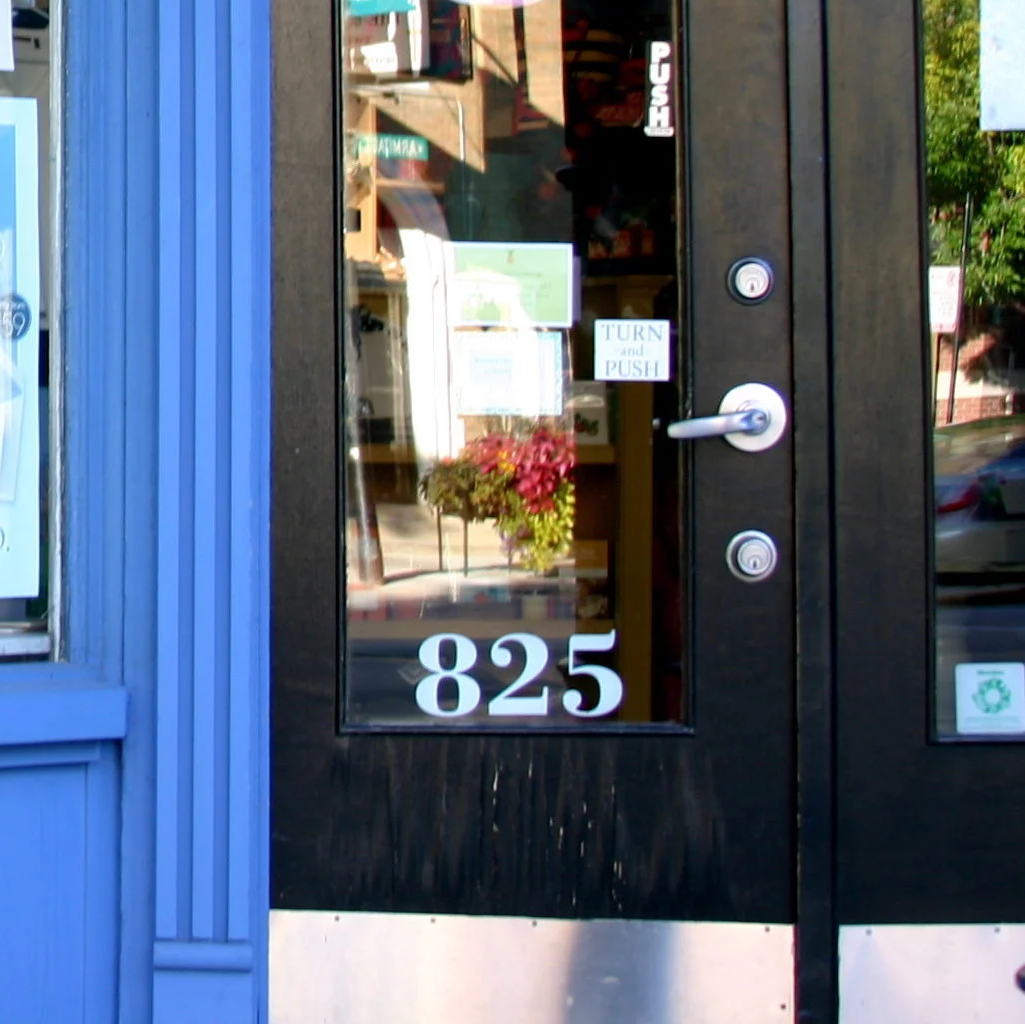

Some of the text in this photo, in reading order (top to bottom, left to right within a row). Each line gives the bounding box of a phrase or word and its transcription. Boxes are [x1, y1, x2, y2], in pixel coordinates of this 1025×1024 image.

[649, 40, 672, 128] PUSH
[600, 323, 663, 342] TURN
[620, 343, 644, 357] and
[605, 360, 659, 378] PUSH
[415, 628, 623, 718] 825
